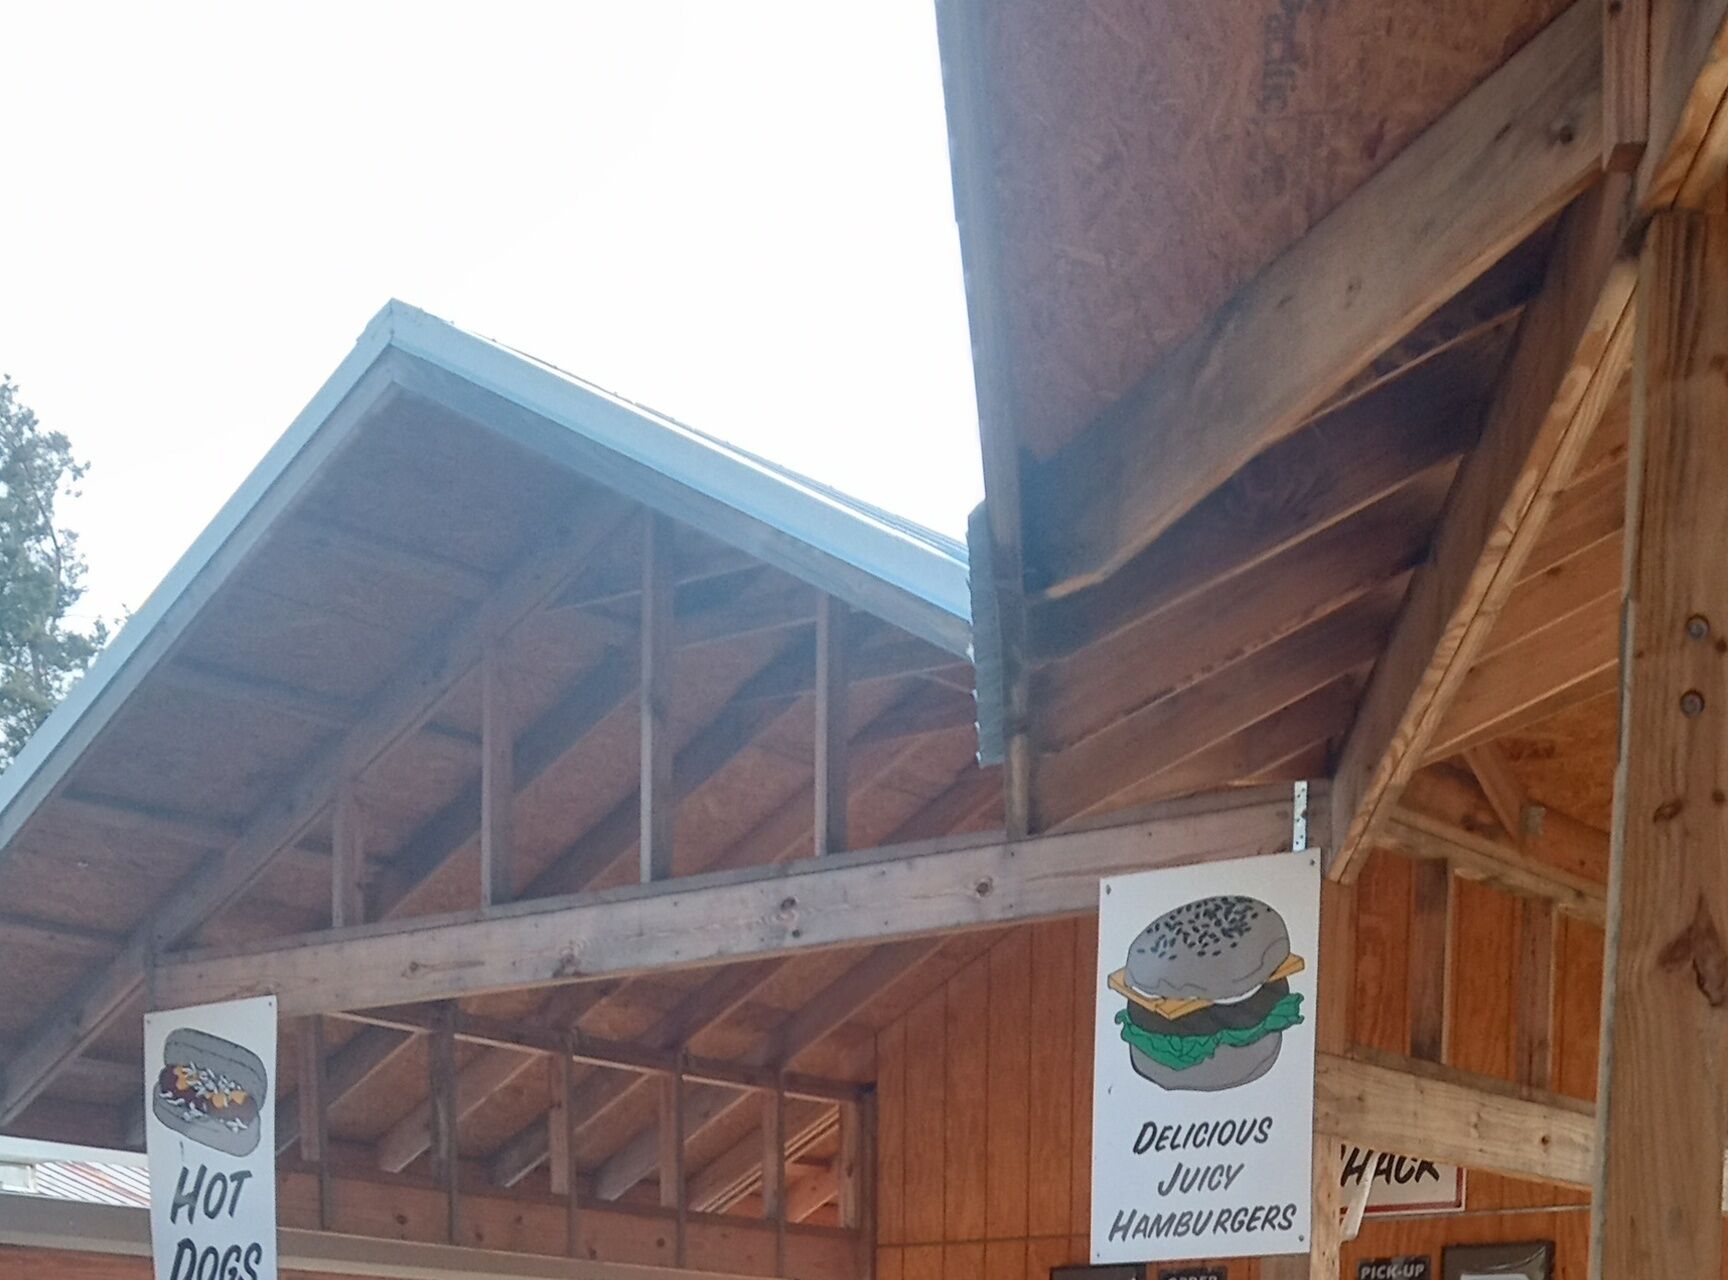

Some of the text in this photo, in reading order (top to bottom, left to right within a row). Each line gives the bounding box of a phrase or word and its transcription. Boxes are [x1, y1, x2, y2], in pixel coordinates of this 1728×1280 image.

[1132, 1116, 1273, 1155] DELICIOUS
[1157, 1162, 1245, 1197] JUICY
[1340, 1144, 1440, 1187] HACK
[169, 1163, 253, 1225] HOT
[1108, 1203, 1297, 1243] HAMBURGERS
[1360, 1263, 1425, 1280] PICK-UP
